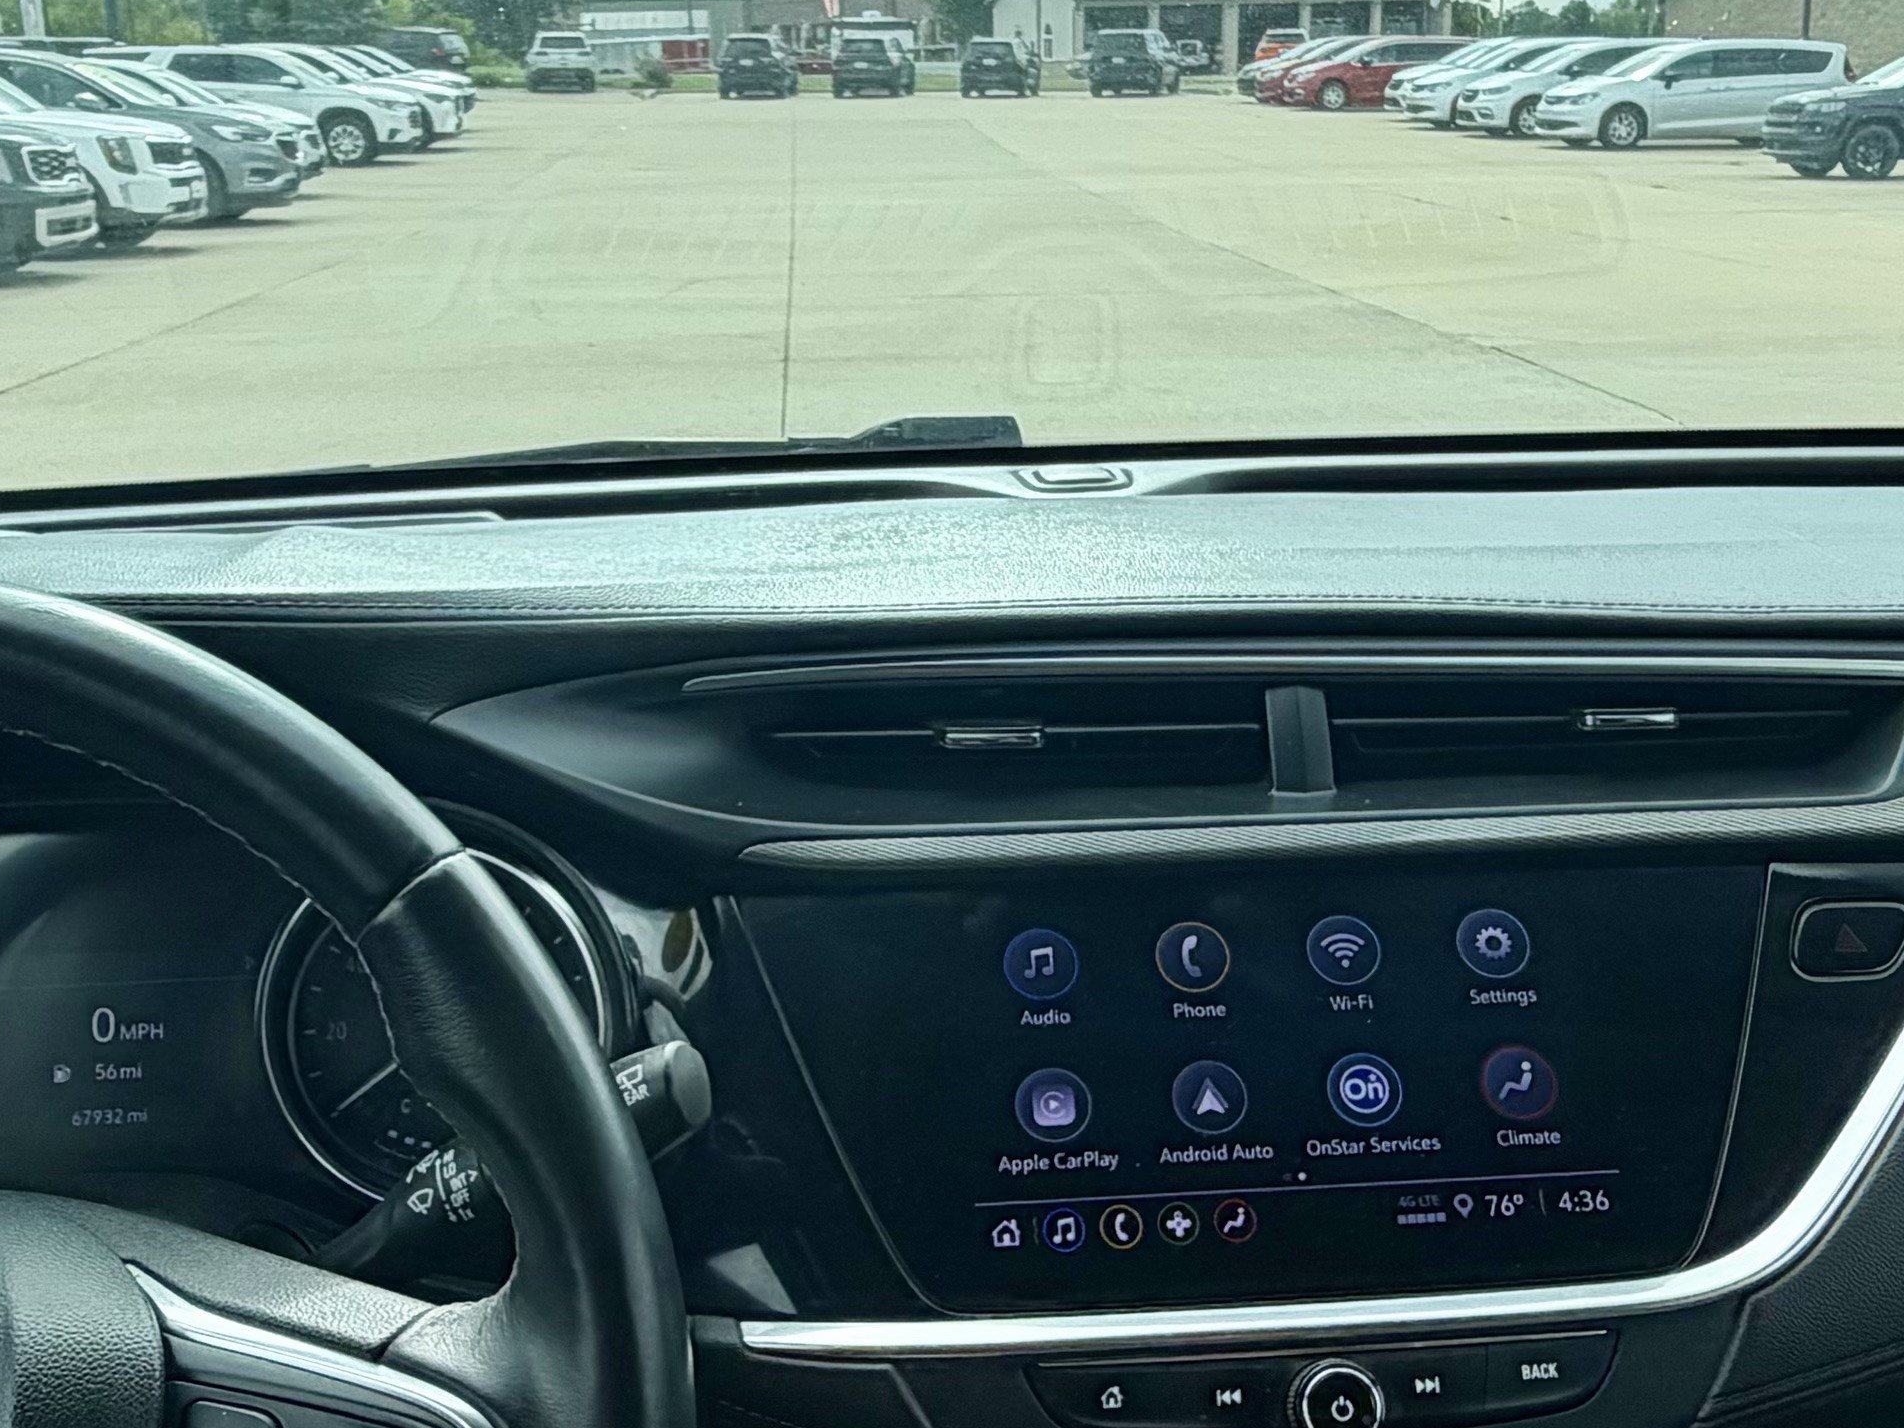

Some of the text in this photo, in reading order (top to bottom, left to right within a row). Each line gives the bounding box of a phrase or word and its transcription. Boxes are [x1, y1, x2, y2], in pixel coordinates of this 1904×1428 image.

[1329, 994, 1374, 1010] Wi-Fi
[1470, 988, 1537, 1007] Settings
[1020, 1010, 1071, 1026] Audio
[1173, 1002, 1226, 1018] Phone
[91, 1007, 164, 1043] 0 MPH
[95, 1062, 143, 1080] 56 mi
[1345, 1073, 1384, 1100] On
[401, 1098, 411, 1114] C
[72, 1108, 124, 1126] 67932
[1306, 1135, 1441, 1156] OnStar Services
[1497, 1130, 1561, 1146] Climate
[1159, 1143, 1274, 1163] Android Auto
[998, 1151, 1119, 1175] Apple CarPlay
[1399, 1194, 1441, 1208] 4G LTE
[1558, 1189, 1610, 1213] 4:36
[1521, 1362, 1559, 1381] BACK
